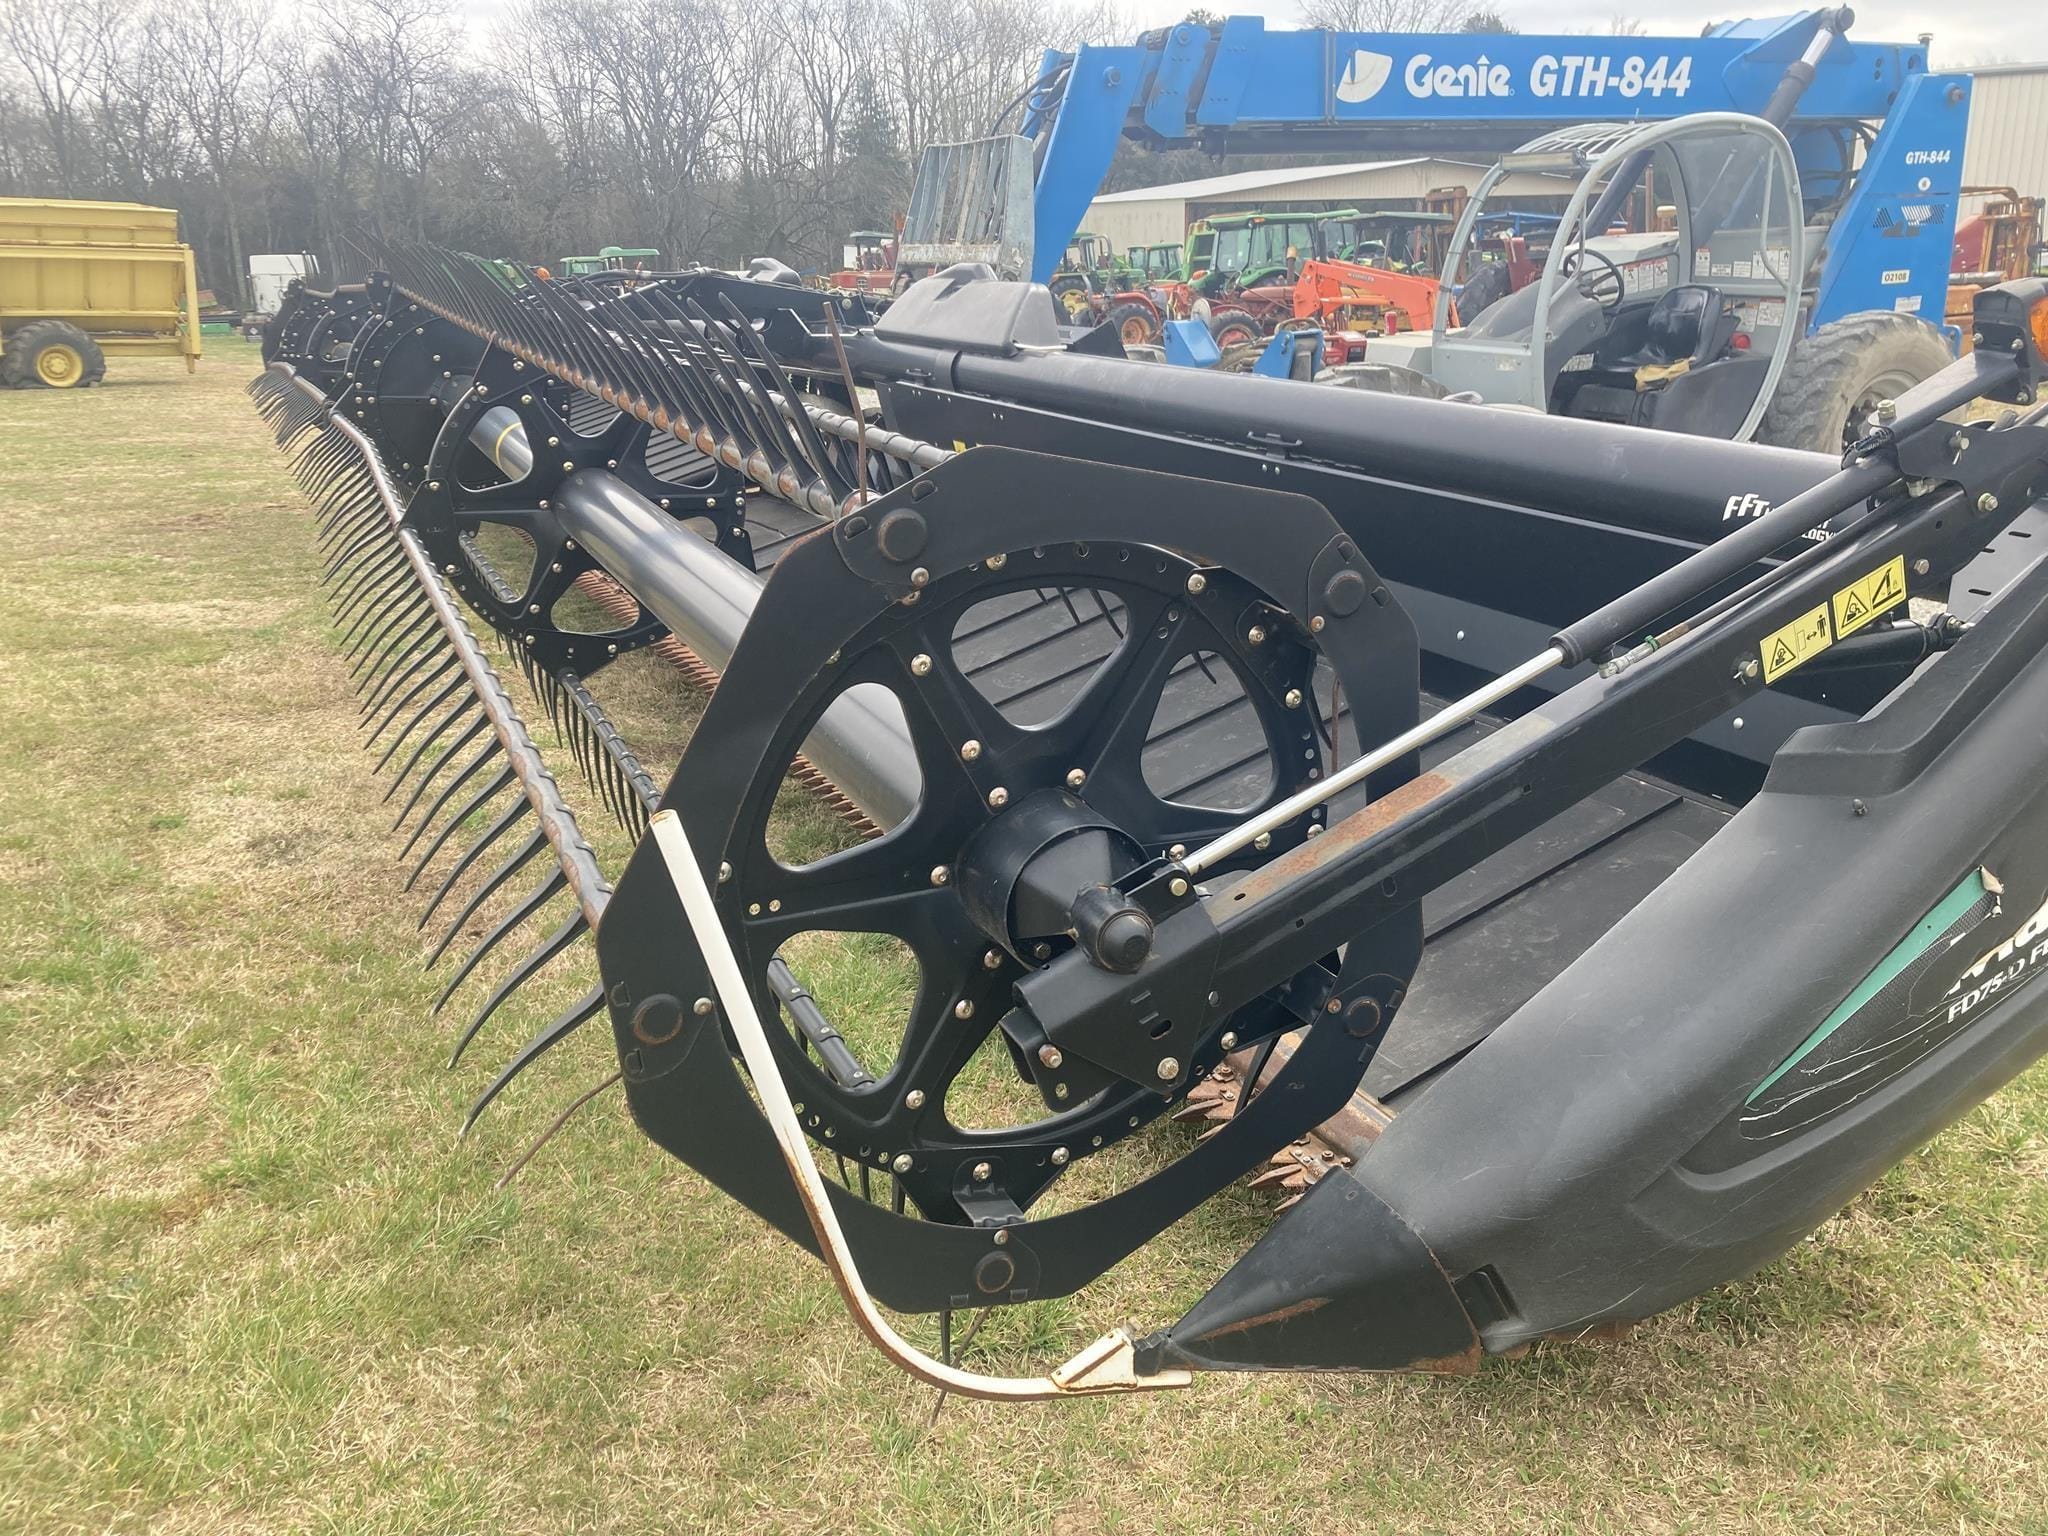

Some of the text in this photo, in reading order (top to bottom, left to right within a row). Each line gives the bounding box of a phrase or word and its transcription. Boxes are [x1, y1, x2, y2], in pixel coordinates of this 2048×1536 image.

[1404, 54, 1693, 98] Genie GTH-844
[1905, 150, 1951, 164] GTH-844
